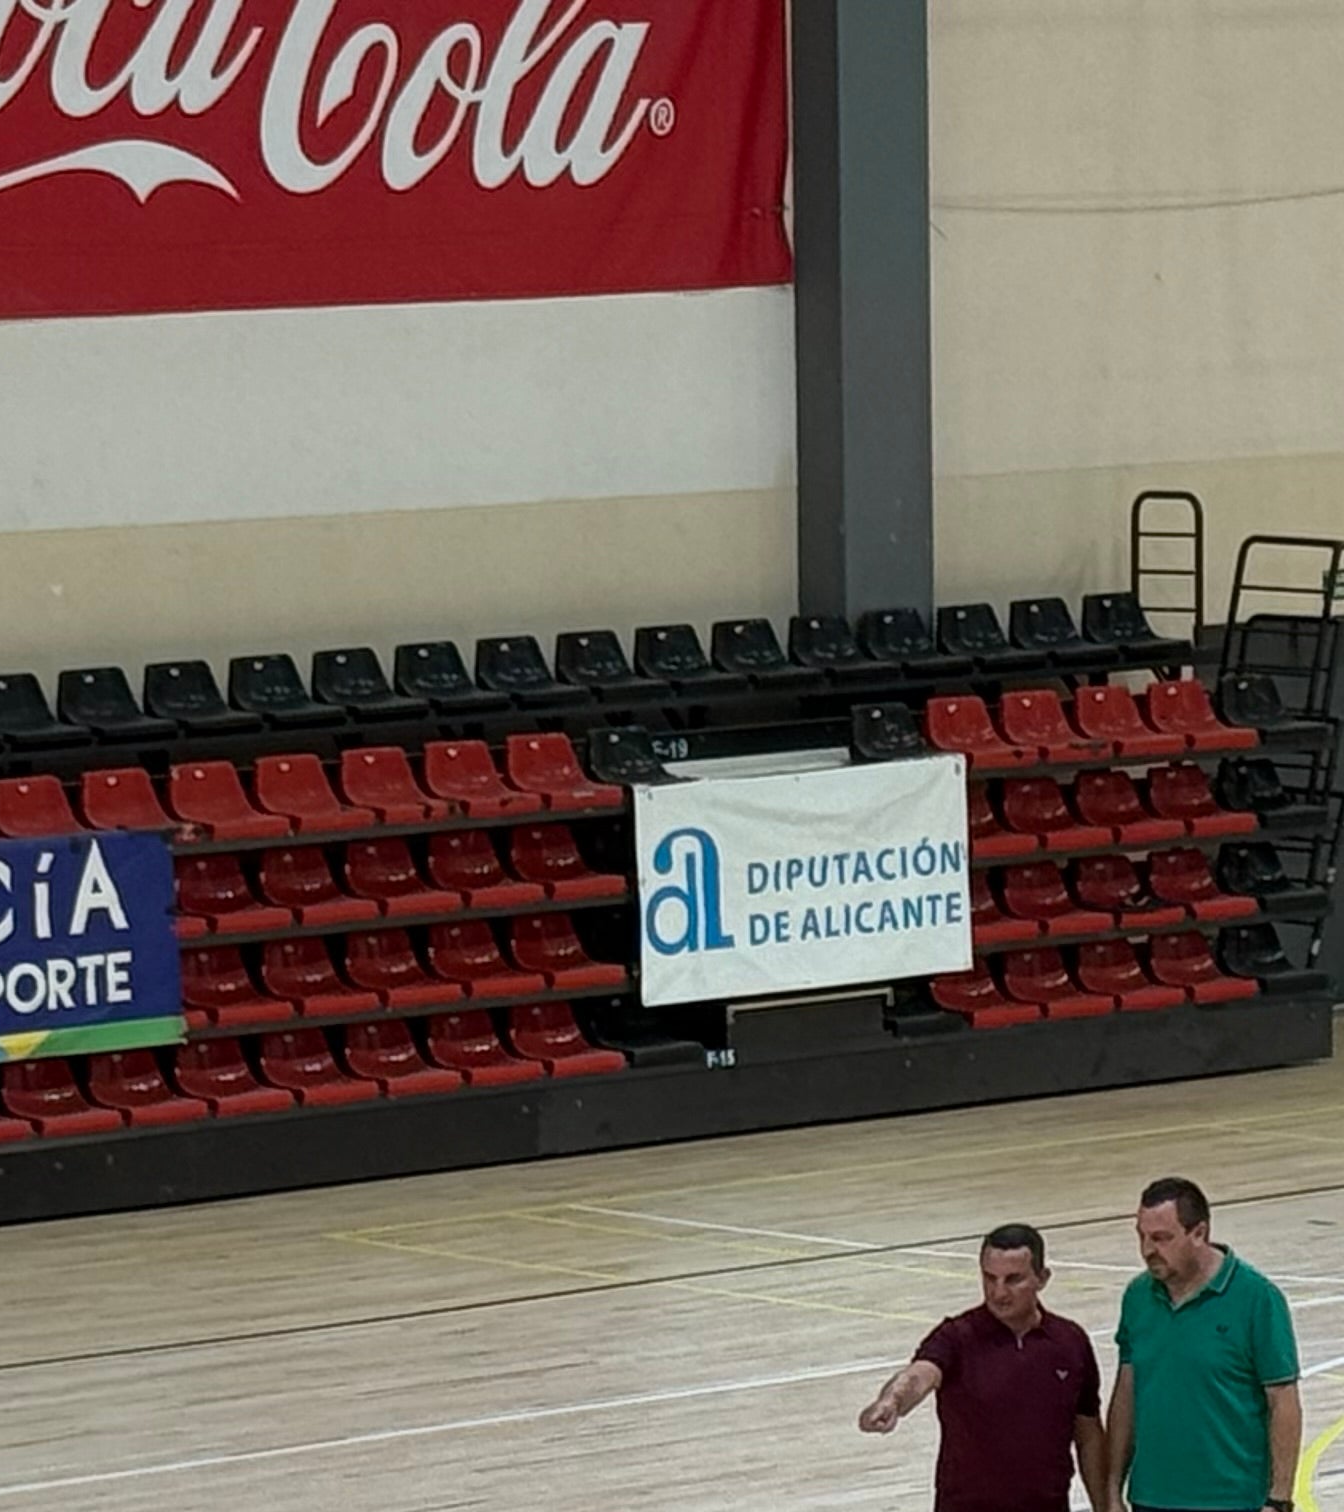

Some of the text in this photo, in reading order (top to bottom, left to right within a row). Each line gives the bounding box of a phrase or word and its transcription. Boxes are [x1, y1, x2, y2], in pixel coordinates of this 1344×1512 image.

[260, 0, 652, 194] Cola
[746, 836, 962, 895] DIPUTACIÓN
[748, 892, 963, 947] DE ALICANTE
